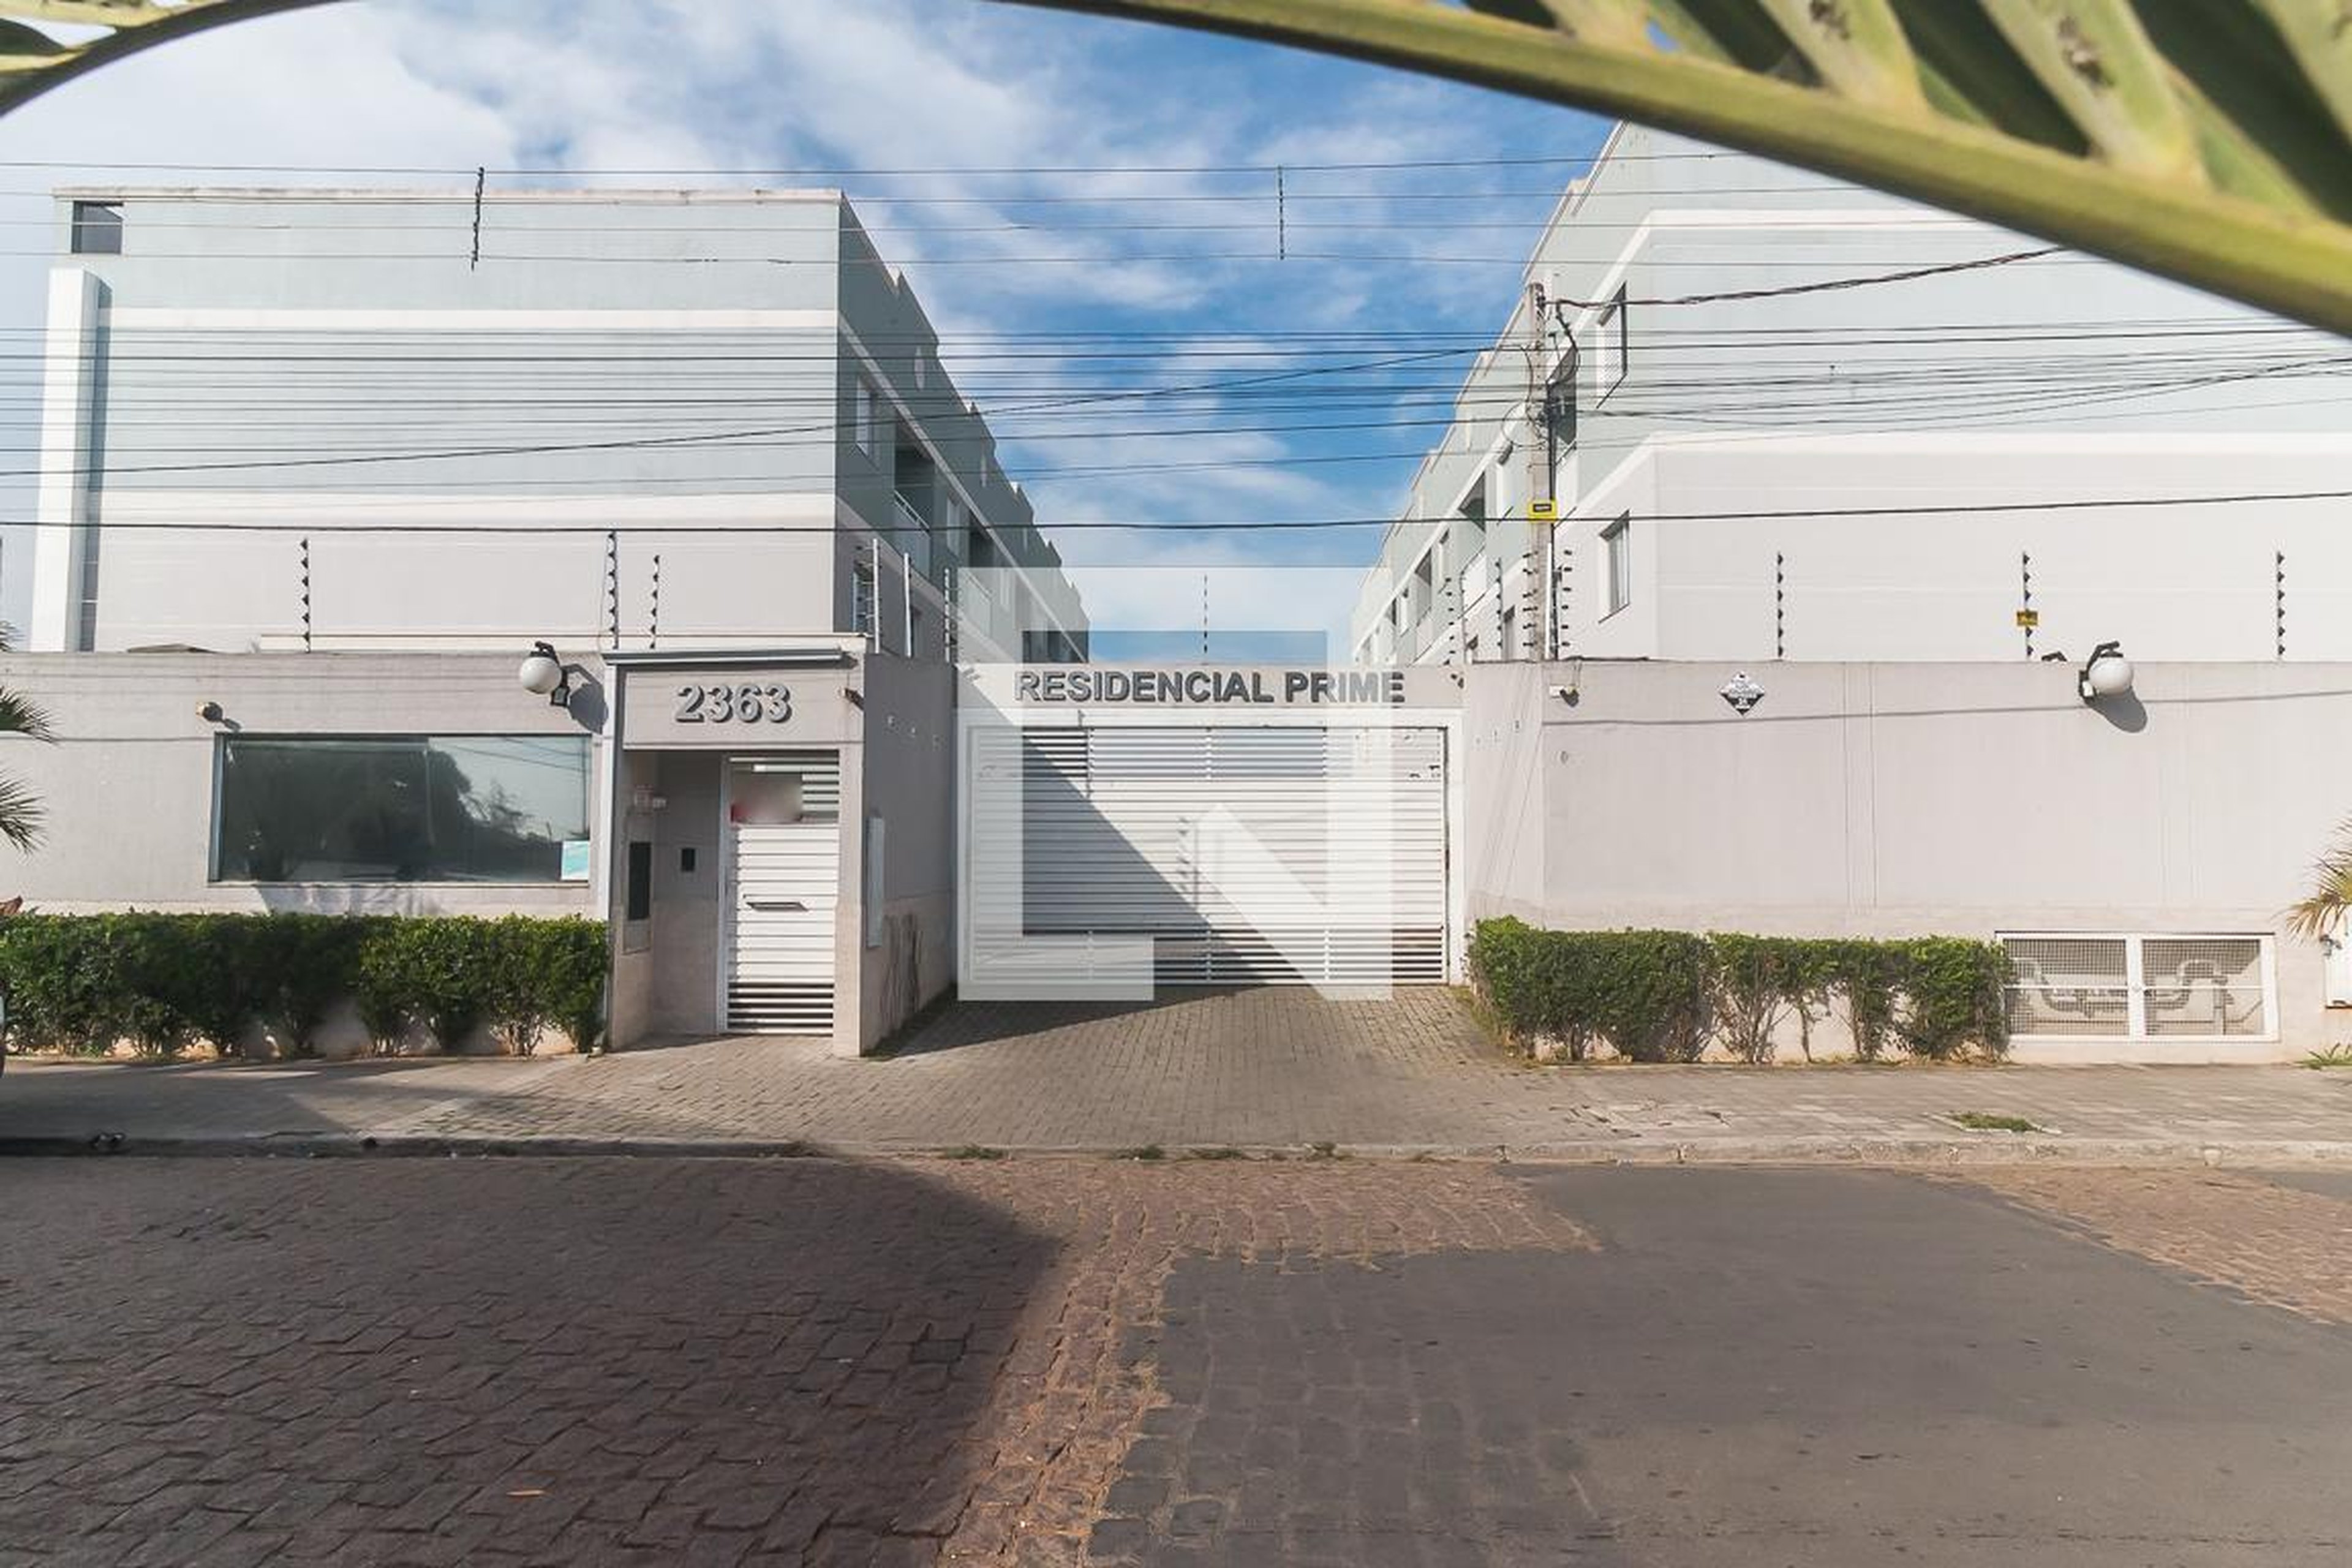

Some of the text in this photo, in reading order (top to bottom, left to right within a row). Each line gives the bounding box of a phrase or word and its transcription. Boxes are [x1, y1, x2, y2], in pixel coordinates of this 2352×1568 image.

[676, 684, 792, 723] 2363
[1015, 671, 1405, 703] RESIDENCIAL PRIME
